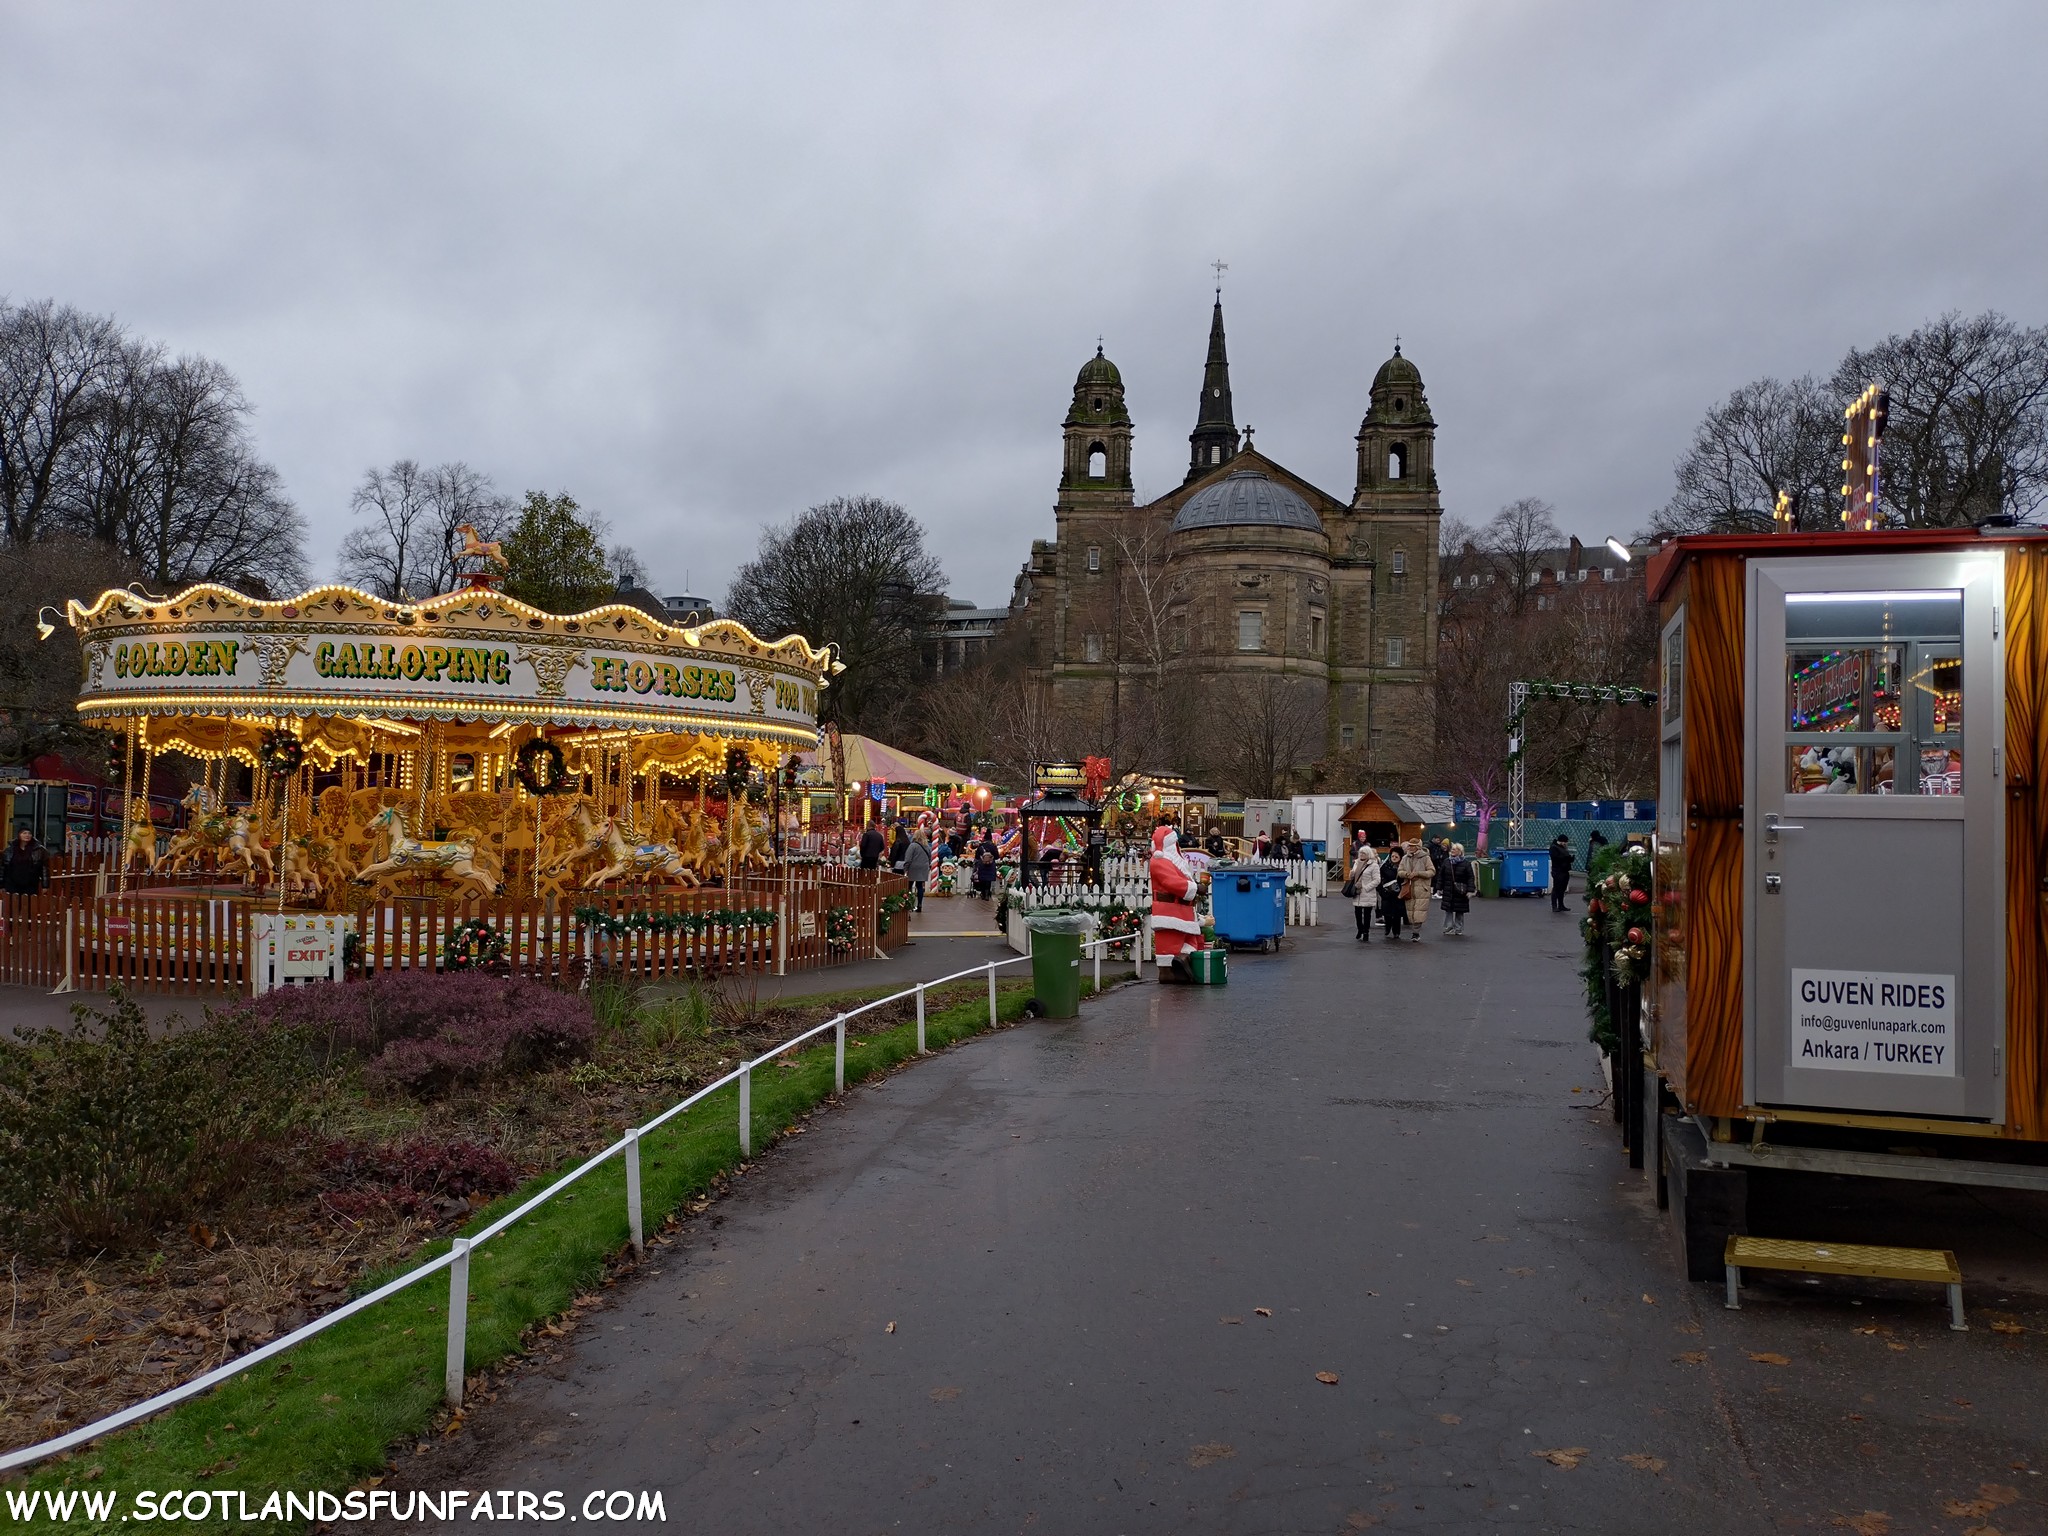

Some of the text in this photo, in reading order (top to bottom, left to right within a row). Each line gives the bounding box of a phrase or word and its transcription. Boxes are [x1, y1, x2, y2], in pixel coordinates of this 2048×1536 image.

[114, 640, 736, 702] GOLDEN GALLOPING HORSES
[776, 679, 799, 713] FOR
[288, 950, 326, 961] EXIT
[1801, 980, 1945, 1009] GUVEN RIDES
[1801, 1014, 1945, 1034] info@guvenlunapark.com
[1802, 1039, 1945, 1064] Ankara / TURKEY
